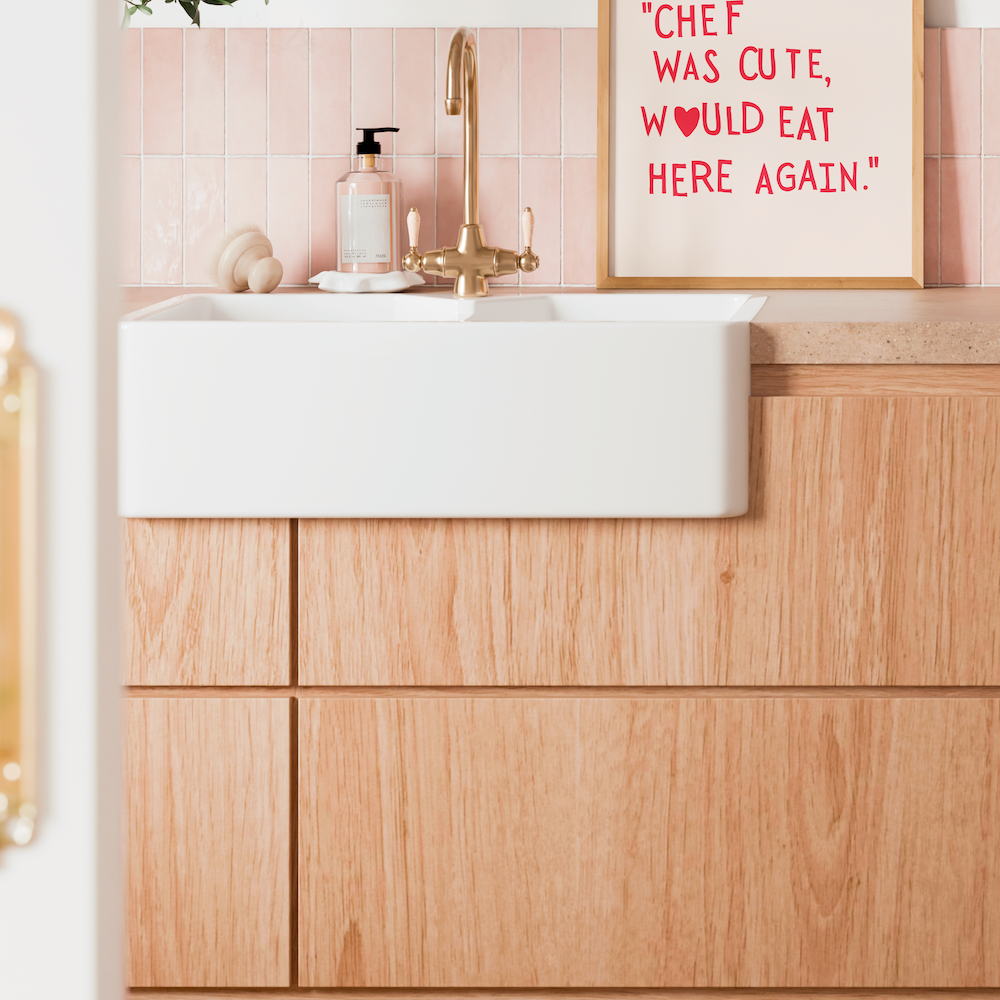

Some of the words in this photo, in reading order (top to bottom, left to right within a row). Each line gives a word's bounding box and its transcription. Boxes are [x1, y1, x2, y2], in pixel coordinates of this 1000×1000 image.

[641, 0, 744, 39] "CHEF
[652, 49, 720, 84] WAS
[738, 45, 831, 88] CUTE,
[779, 105, 834, 142] EAT
[648, 159, 733, 198] HERE
[754, 156, 879, 195] AGAIN."
